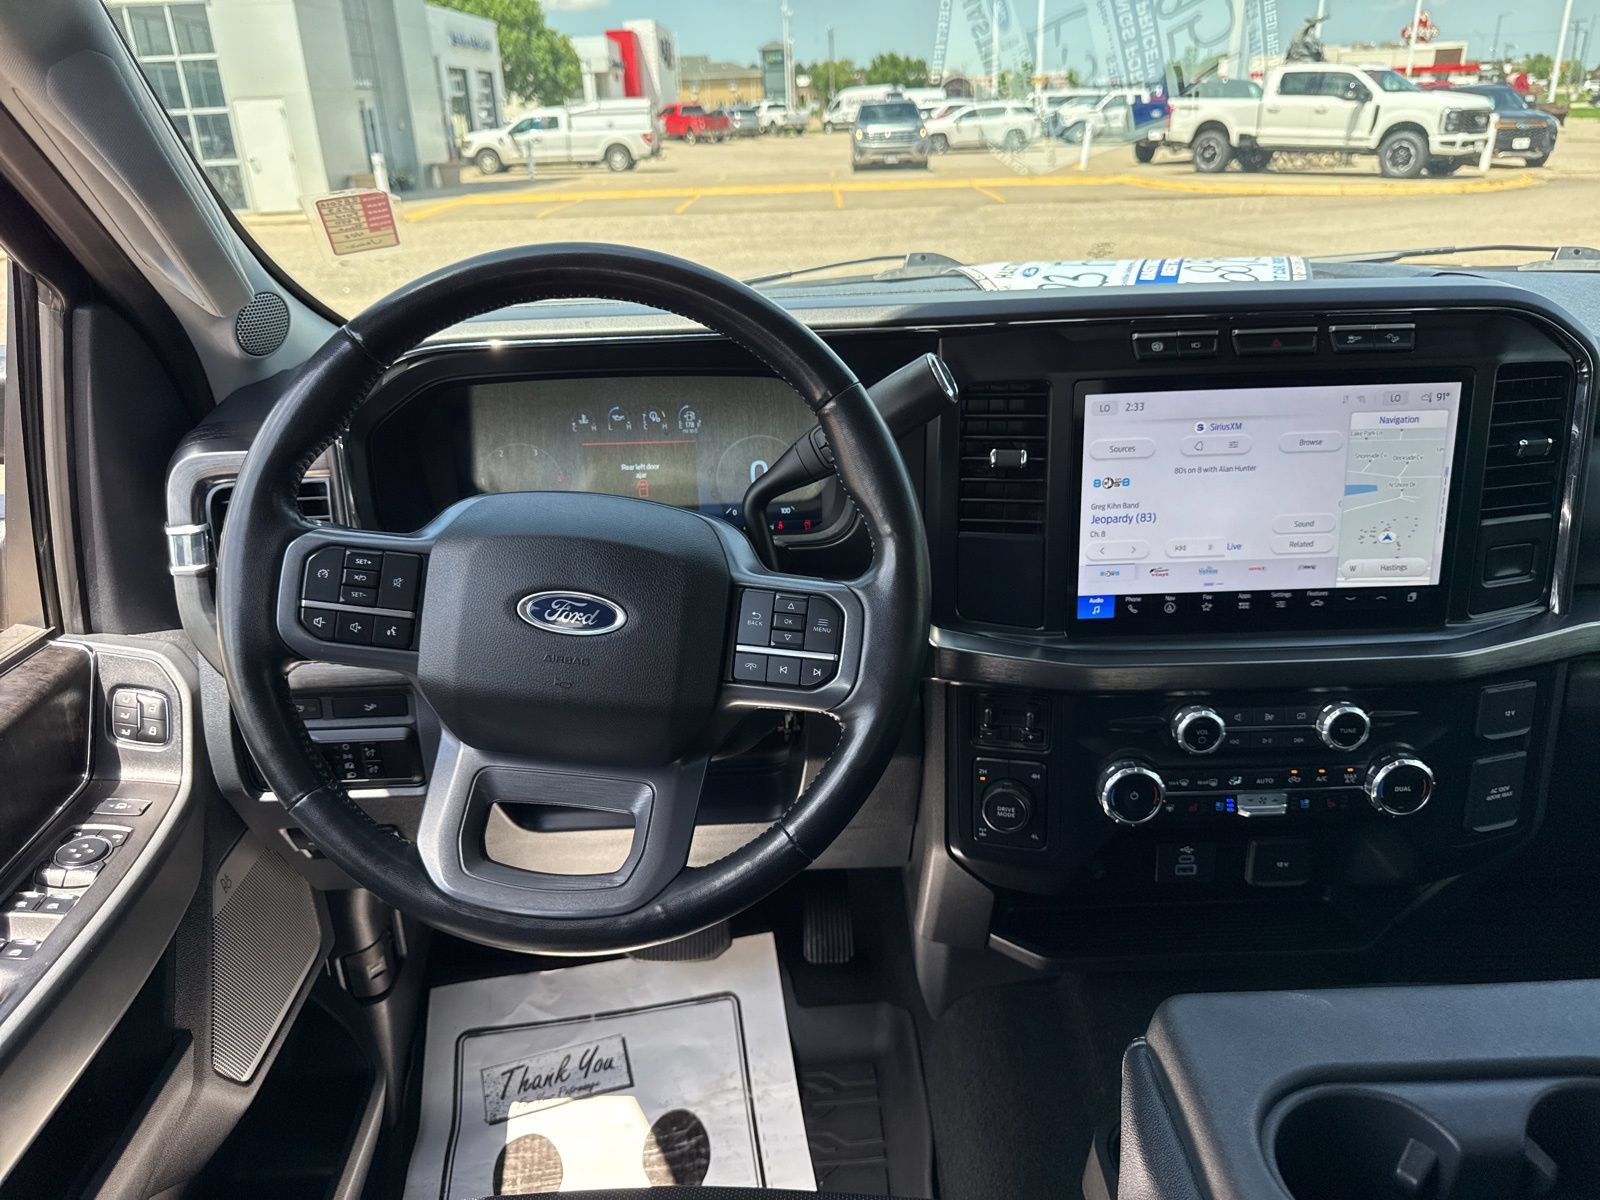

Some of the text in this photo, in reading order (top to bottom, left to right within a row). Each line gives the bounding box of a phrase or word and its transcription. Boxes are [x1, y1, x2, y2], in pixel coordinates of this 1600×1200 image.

[1125, 402, 1144, 412] 2:33
[1380, 416, 1420, 426] Navigation
[1210, 422, 1242, 431] SiriusXM
[1300, 439, 1322, 447] Browse
[1109, 445, 1136, 454] Sources
[1218, 465, 1234, 473] Alan
[1234, 464, 1256, 472] Hunter
[1091, 502, 1105, 511] Greg
[1122, 502, 1140, 510] Band
[1091, 512, 1156, 524] Jeopardy (83)
[1294, 520, 1314, 528] Sound
[1227, 542, 1242, 550] Live
[1290, 540, 1314, 548] Related
[1380, 564, 1408, 572] Hastings
[544, 598, 600, 626] Ford
[812, 626, 831, 634] MENU
[500, 1045, 616, 1100] Thank You
